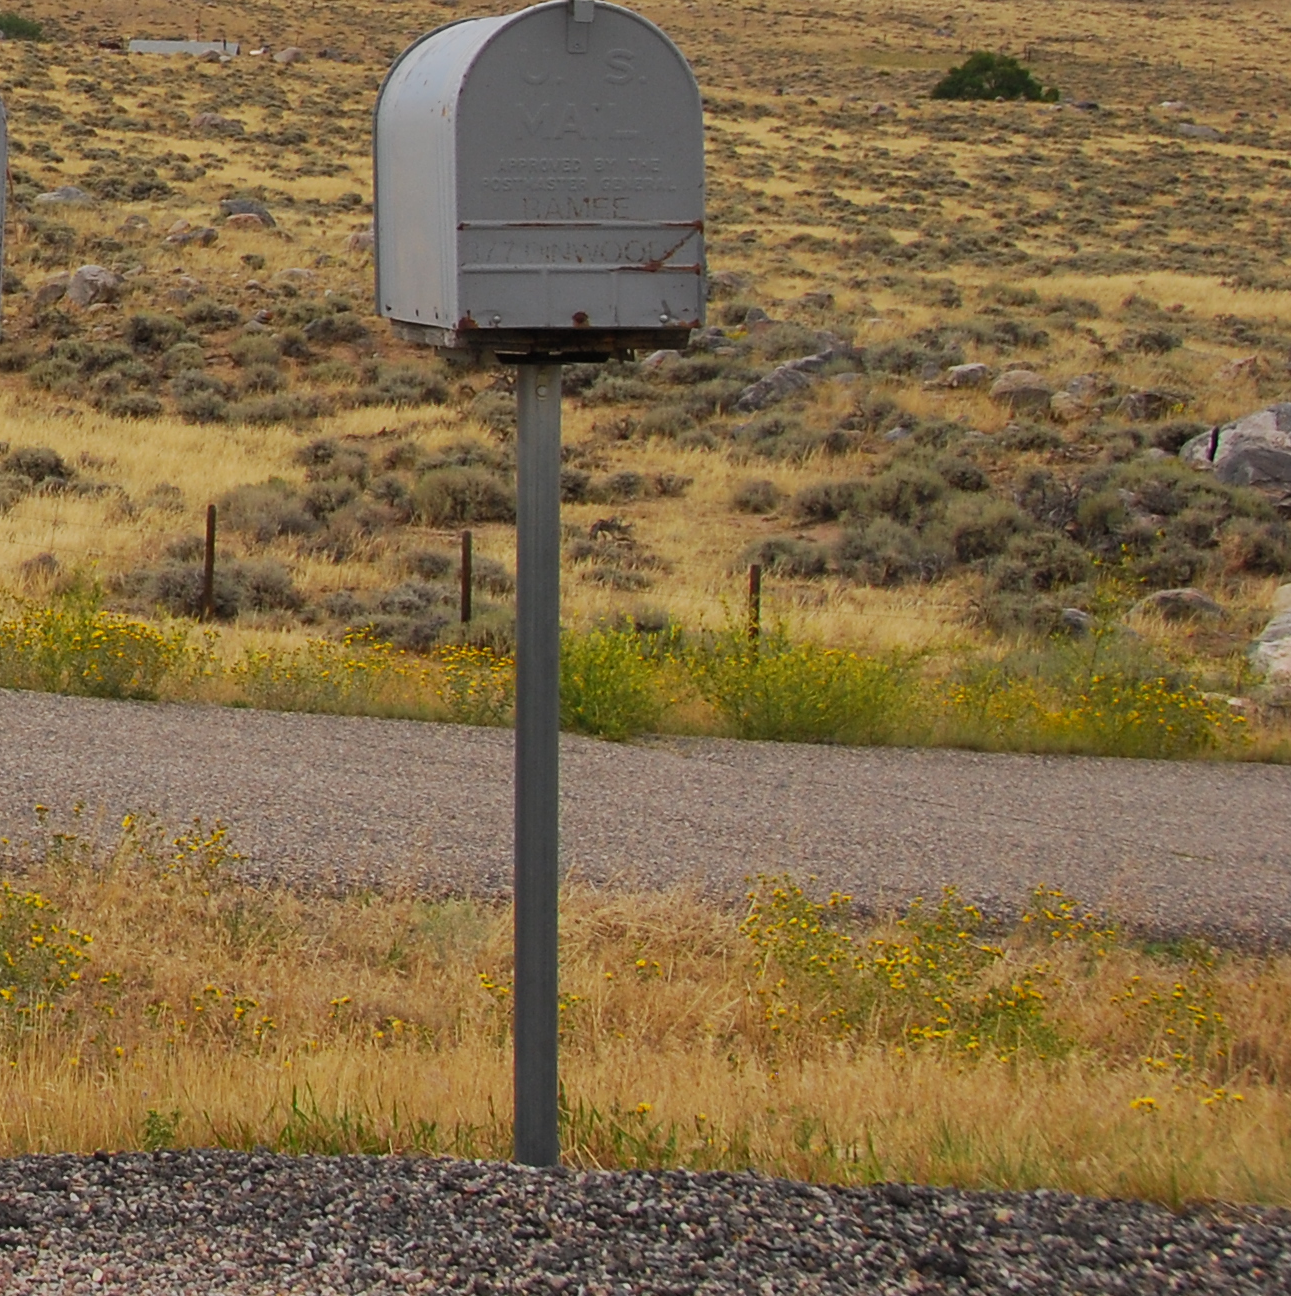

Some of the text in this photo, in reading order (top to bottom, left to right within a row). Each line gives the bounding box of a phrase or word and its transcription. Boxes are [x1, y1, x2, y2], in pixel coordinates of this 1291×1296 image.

[515, 102, 640, 141] MAIL
[497, 157, 661, 174] APPROVED BY THE
[482, 176, 677, 192] POSTMASTER GENERAL
